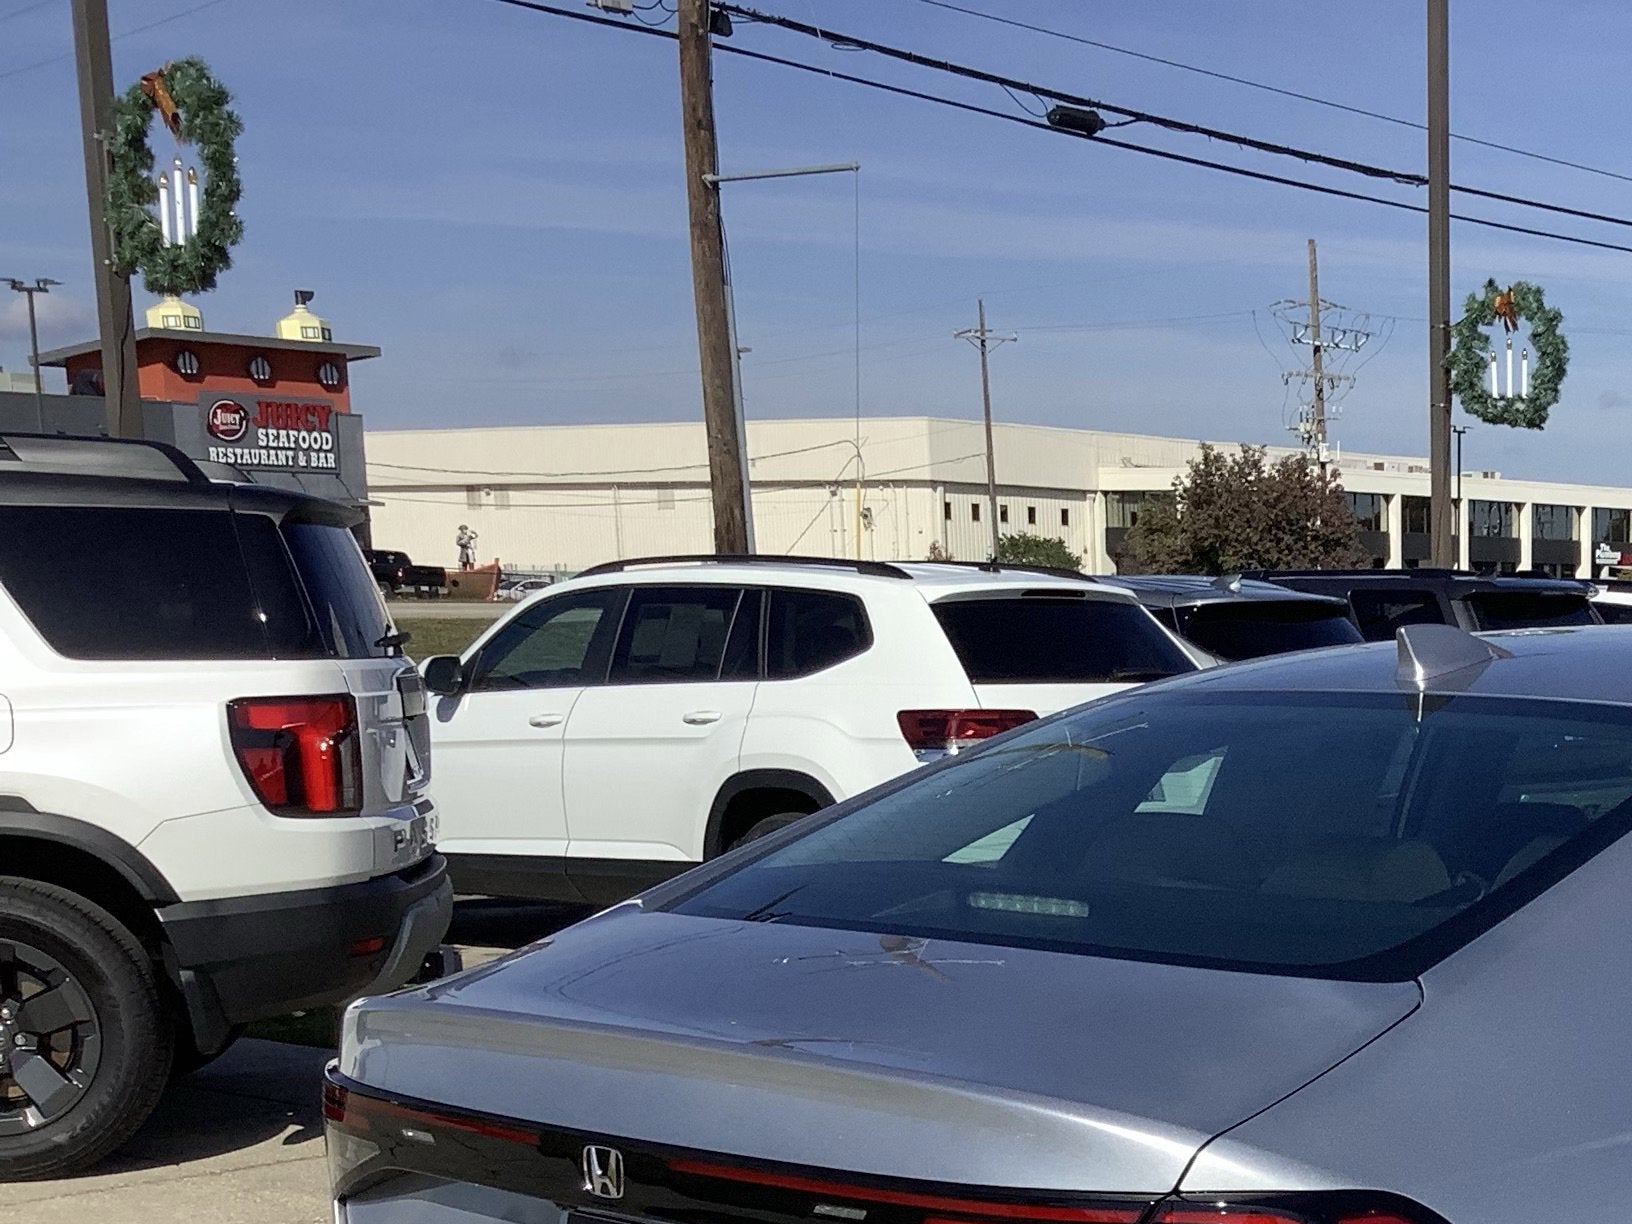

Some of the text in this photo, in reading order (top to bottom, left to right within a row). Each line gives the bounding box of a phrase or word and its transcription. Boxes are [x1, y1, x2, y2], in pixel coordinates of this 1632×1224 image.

[213, 409, 241, 425] JUICY
[252, 401, 331, 432] JUICY
[257, 428, 333, 451] SEAFOOD
[208, 446, 336, 468] RESTAURANT & BAR
